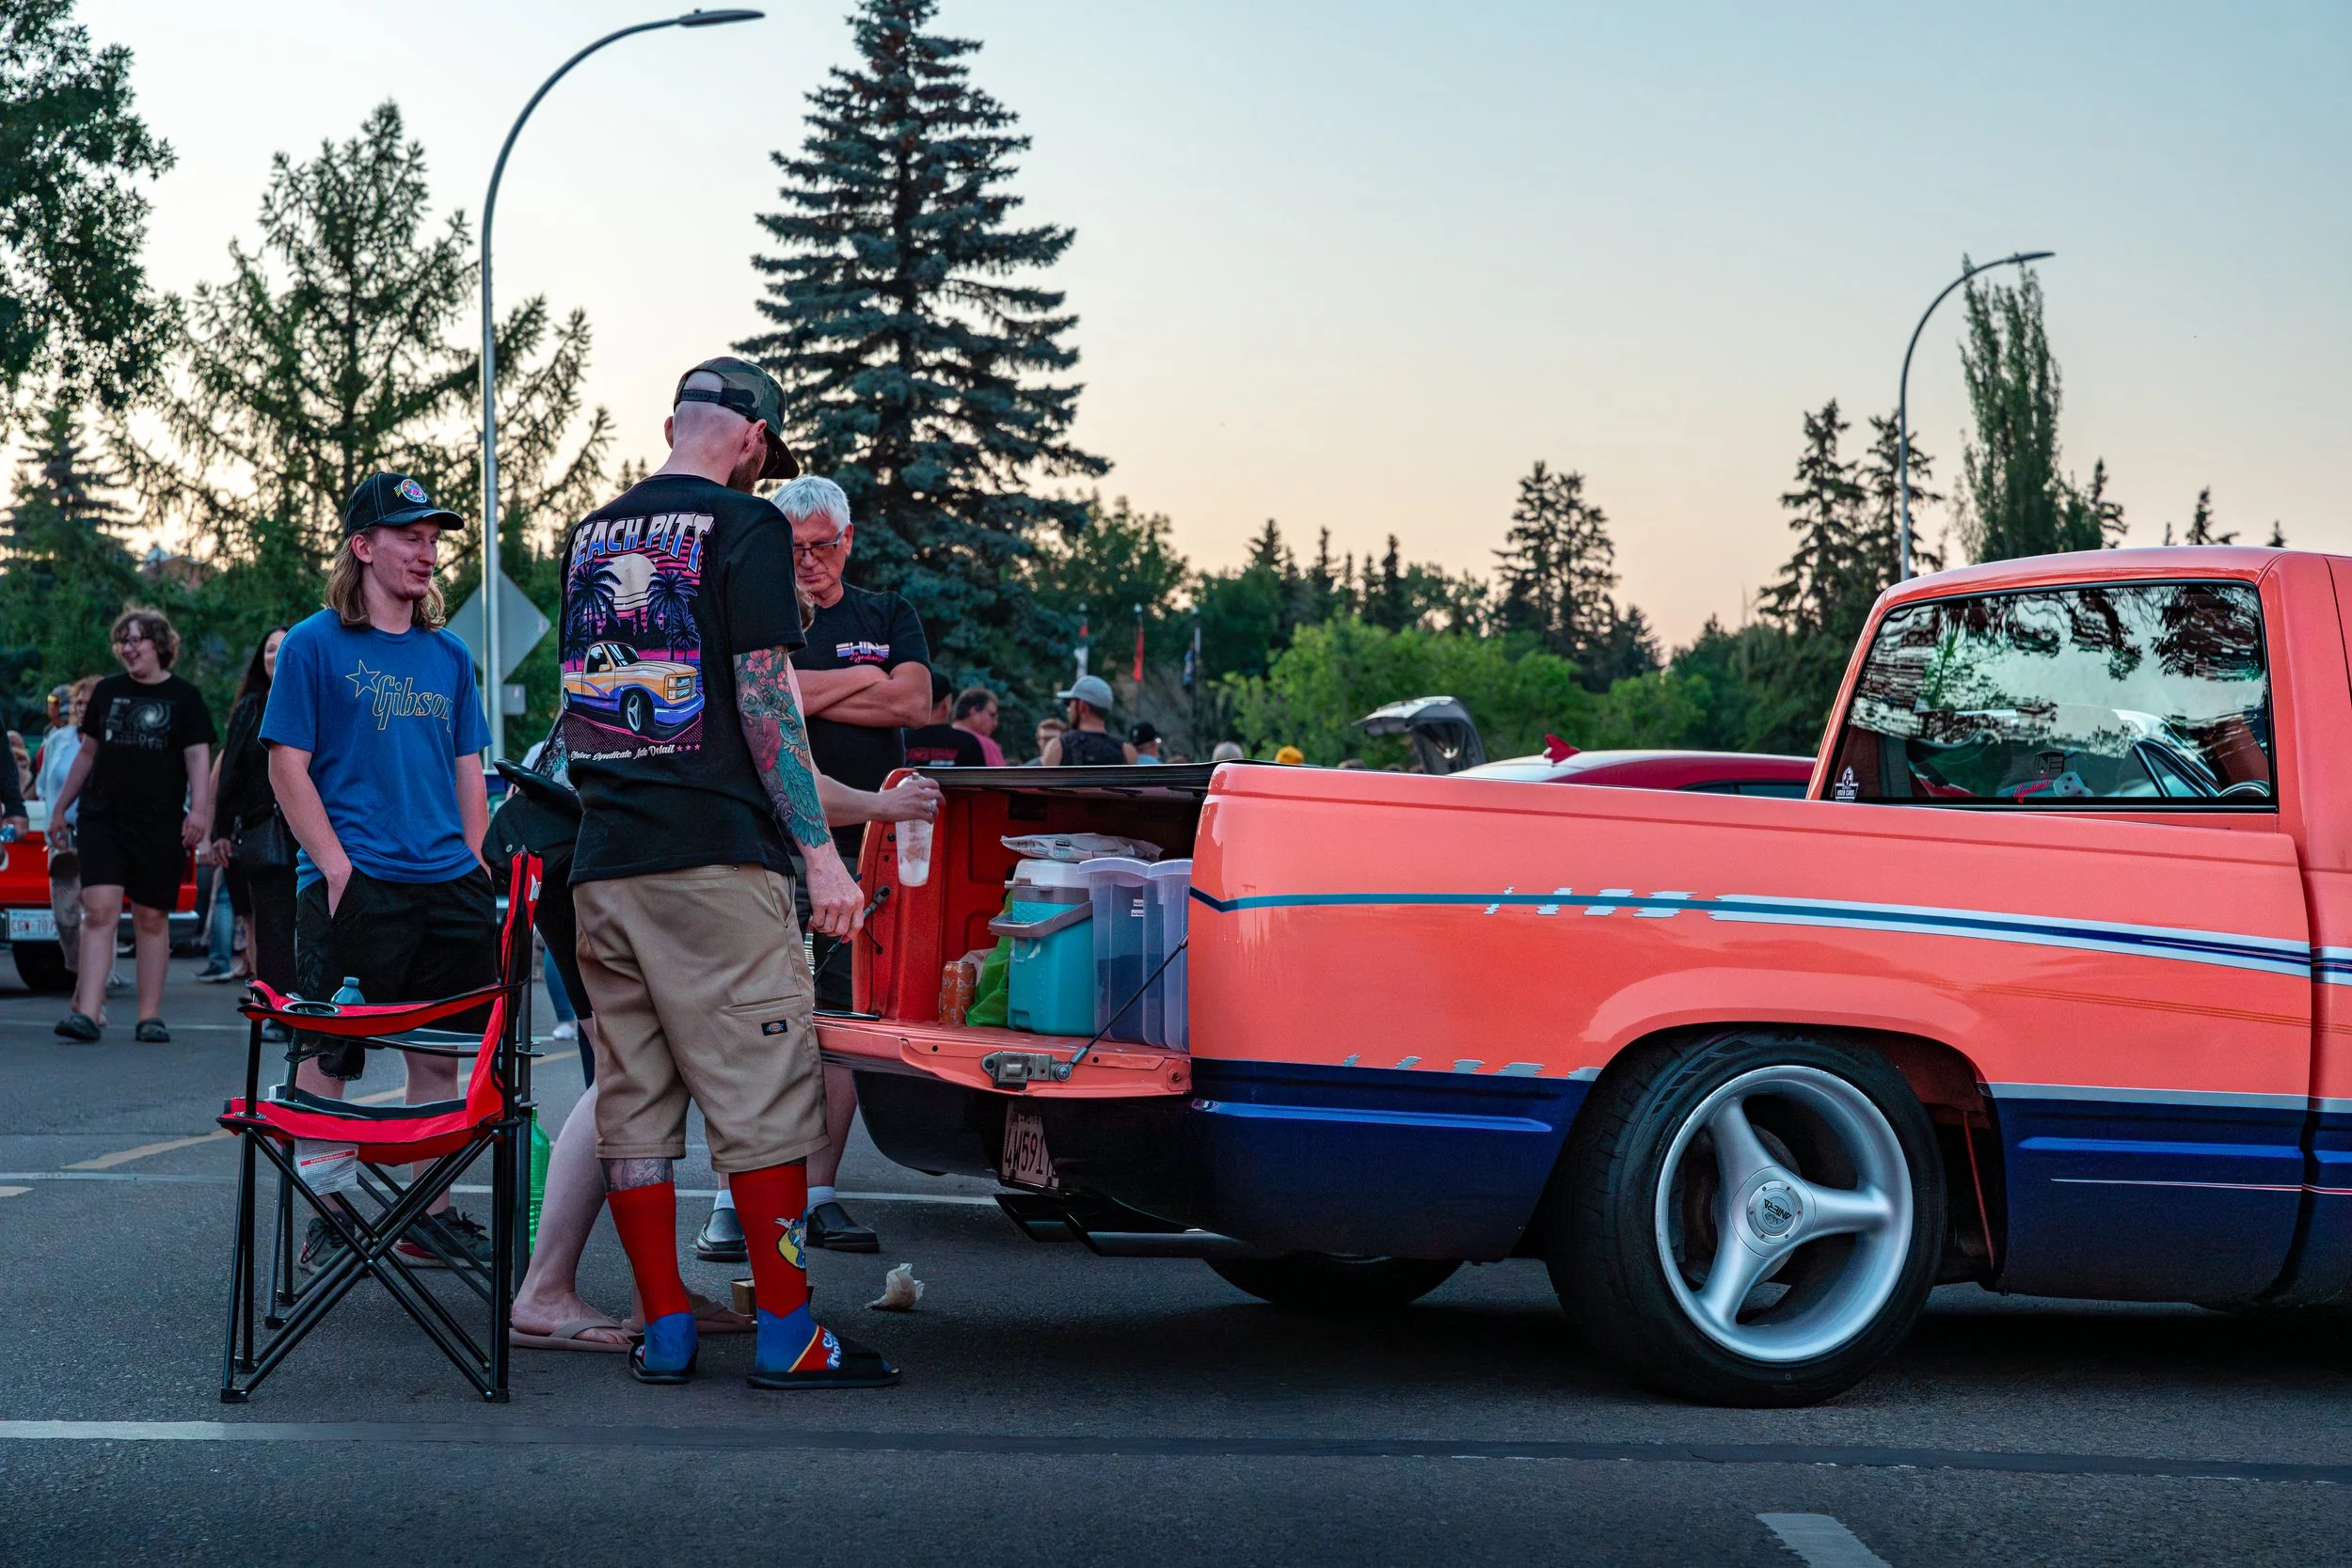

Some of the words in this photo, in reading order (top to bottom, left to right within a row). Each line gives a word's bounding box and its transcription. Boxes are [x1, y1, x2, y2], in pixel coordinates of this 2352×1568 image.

[645, 513, 715, 574] PITT
[592, 750, 632, 761] Syndicate
[648, 744, 675, 756] Detail
[1764, 1198, 1792, 1220] ANTERA
